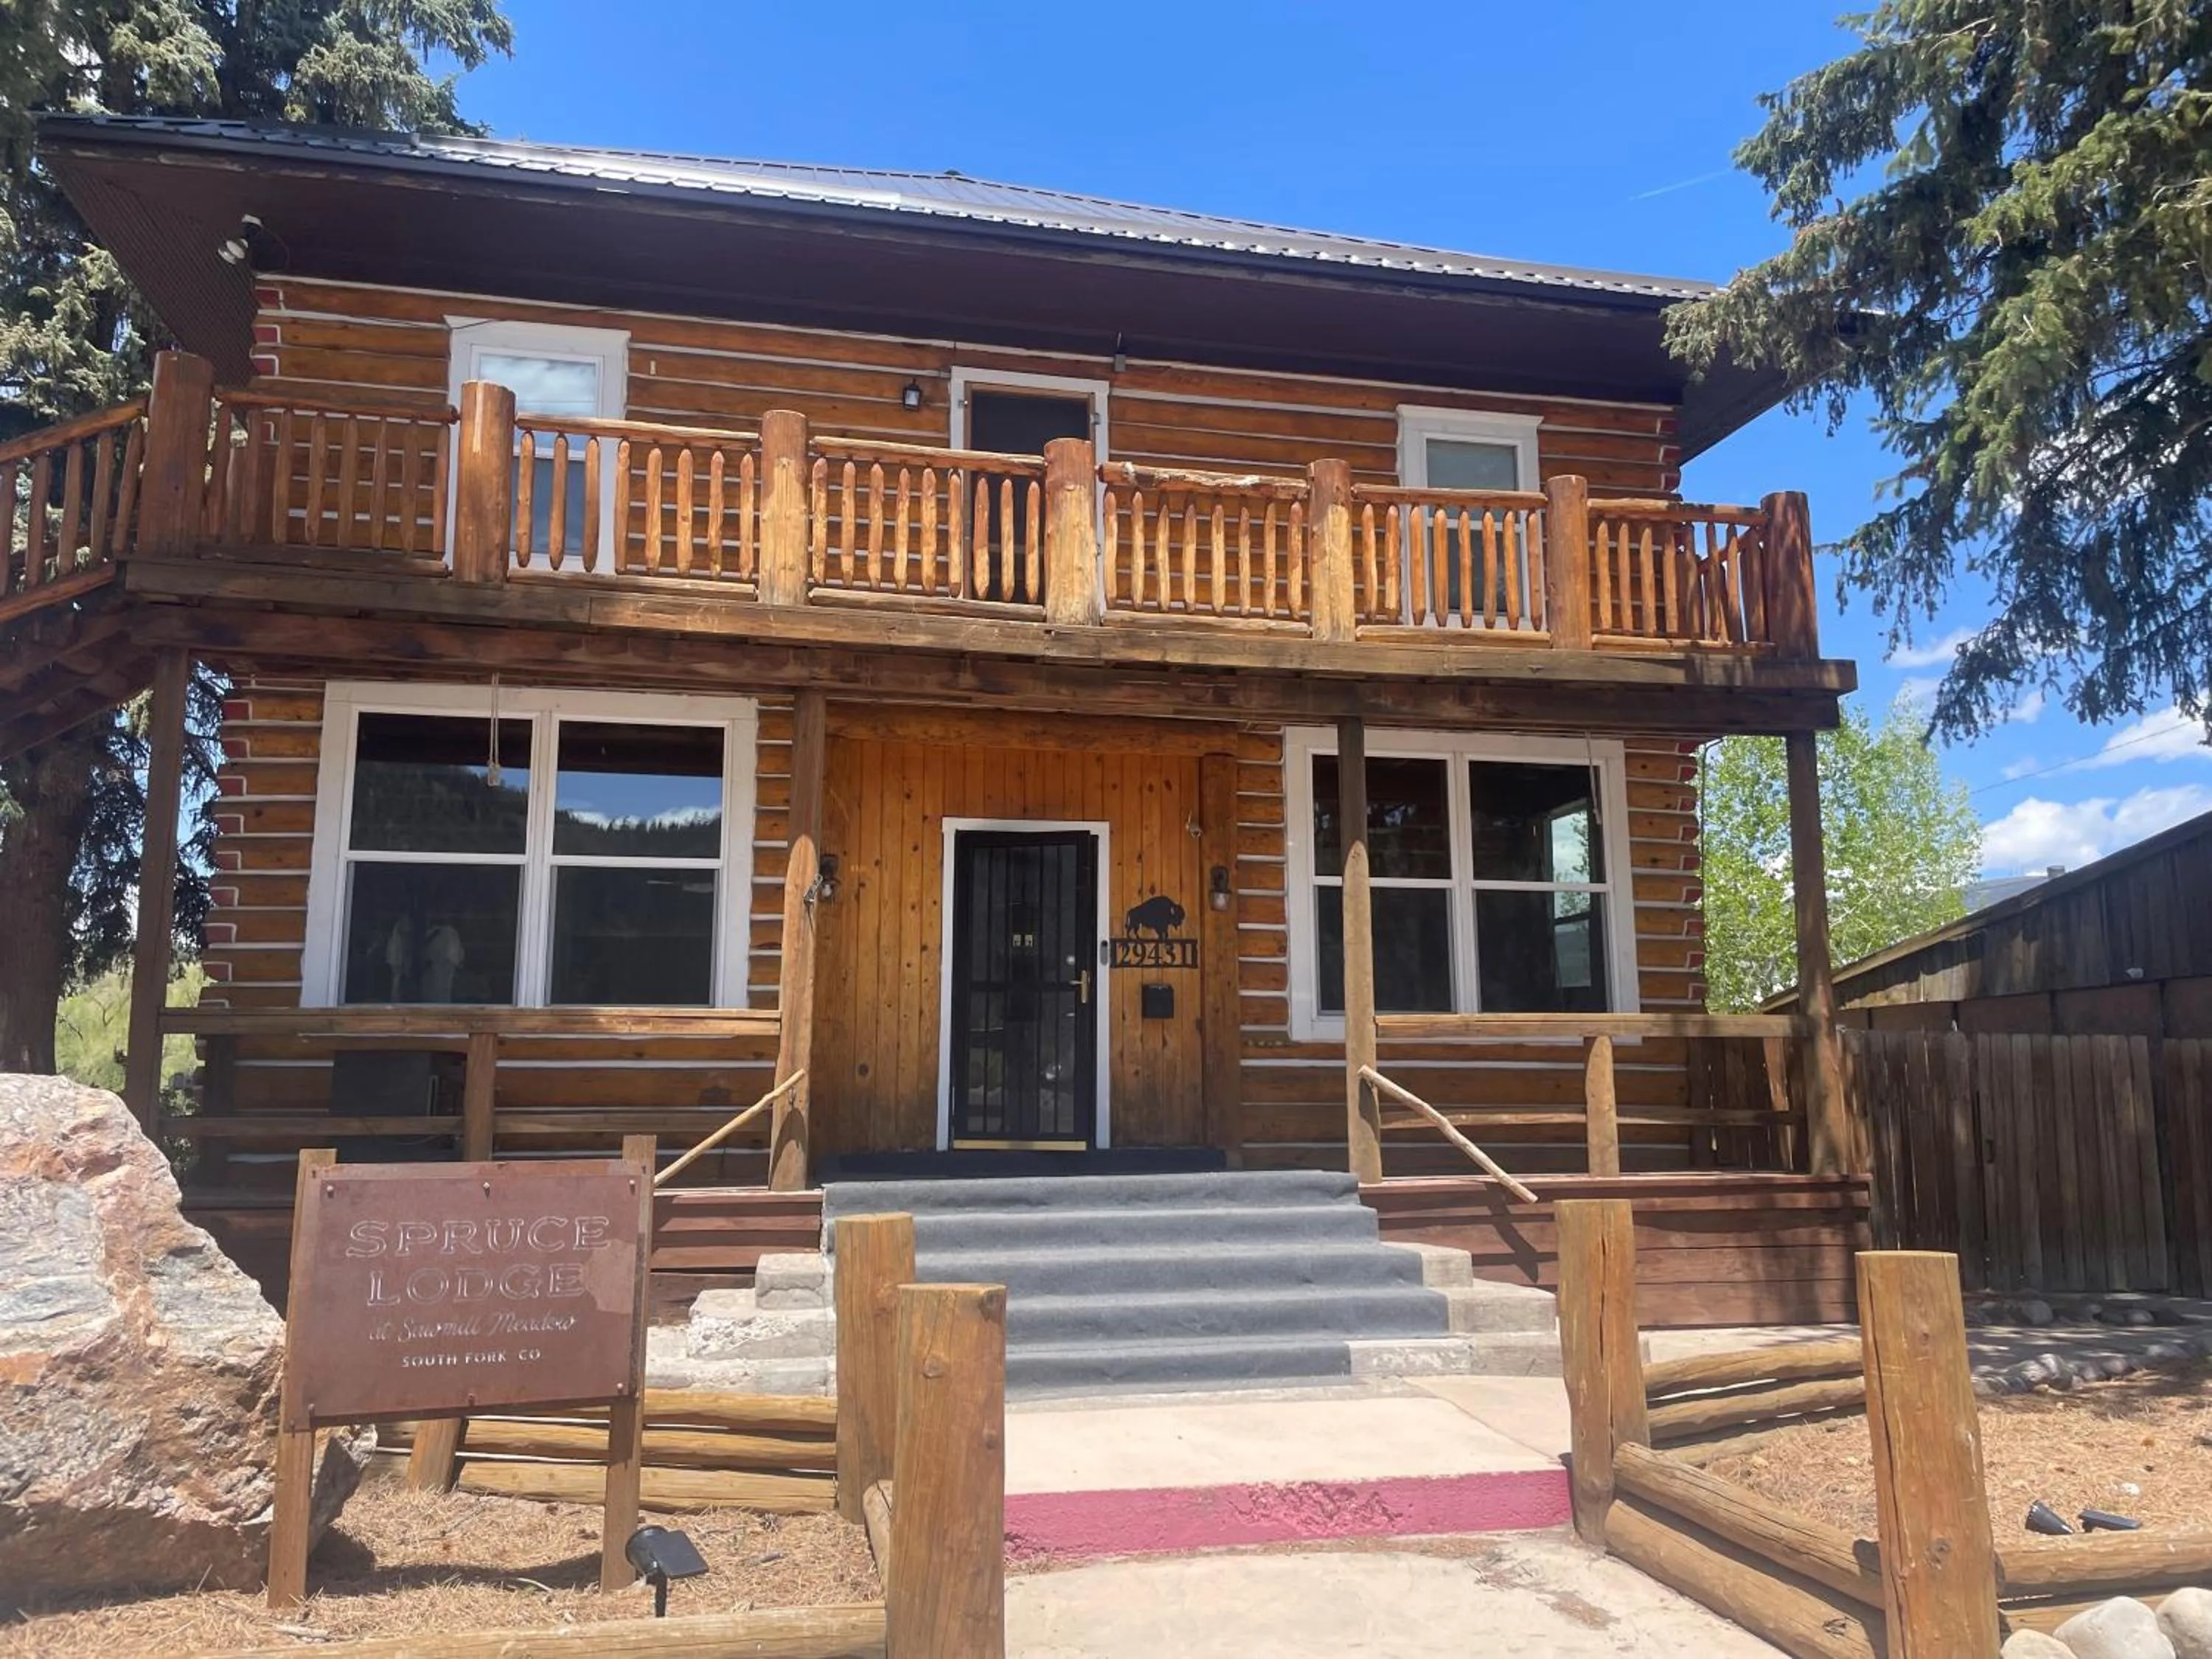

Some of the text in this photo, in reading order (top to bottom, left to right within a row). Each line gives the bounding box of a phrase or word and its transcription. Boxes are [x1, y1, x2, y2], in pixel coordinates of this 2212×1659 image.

[1118, 942, 1187, 966] 29431
[345, 1215, 611, 1258] SPRUCE
[366, 1262, 585, 1307] LODGE
[402, 1349, 540, 1368] SOUTH FORK CO
